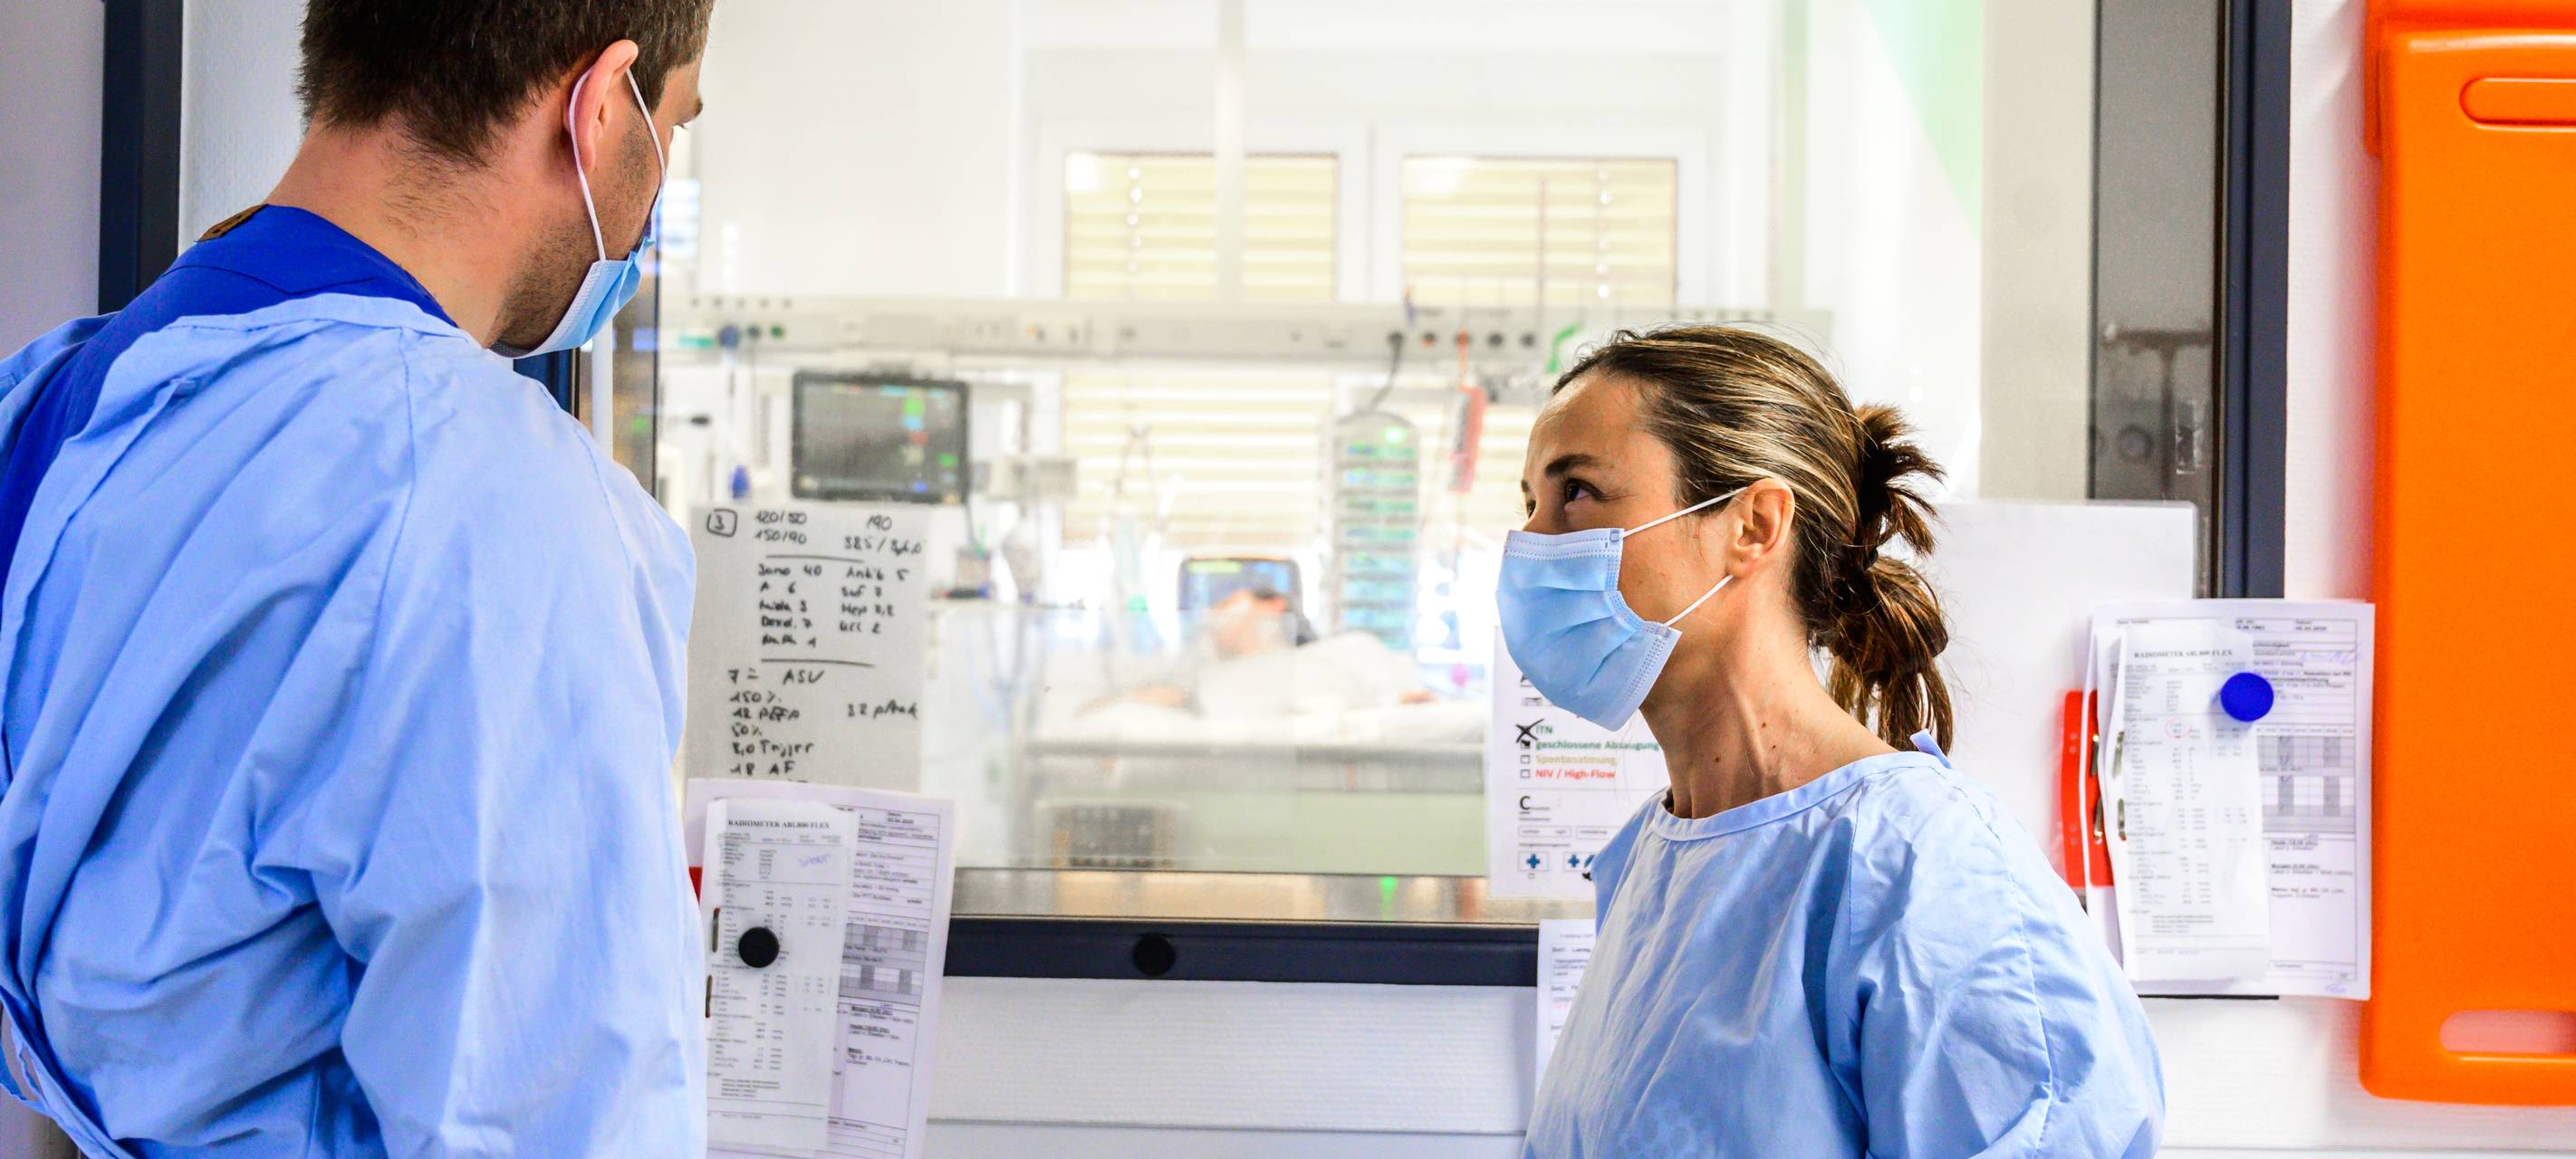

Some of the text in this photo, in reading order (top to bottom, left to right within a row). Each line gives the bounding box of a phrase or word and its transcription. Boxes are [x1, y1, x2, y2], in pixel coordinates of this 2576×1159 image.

[1536, 739, 1659, 752] geschlossene Absaugung
[1535, 769, 1553, 779] NIV
[1565, 769, 1616, 781] High-Flow
[727, 819, 781, 829] RADIOMETER
